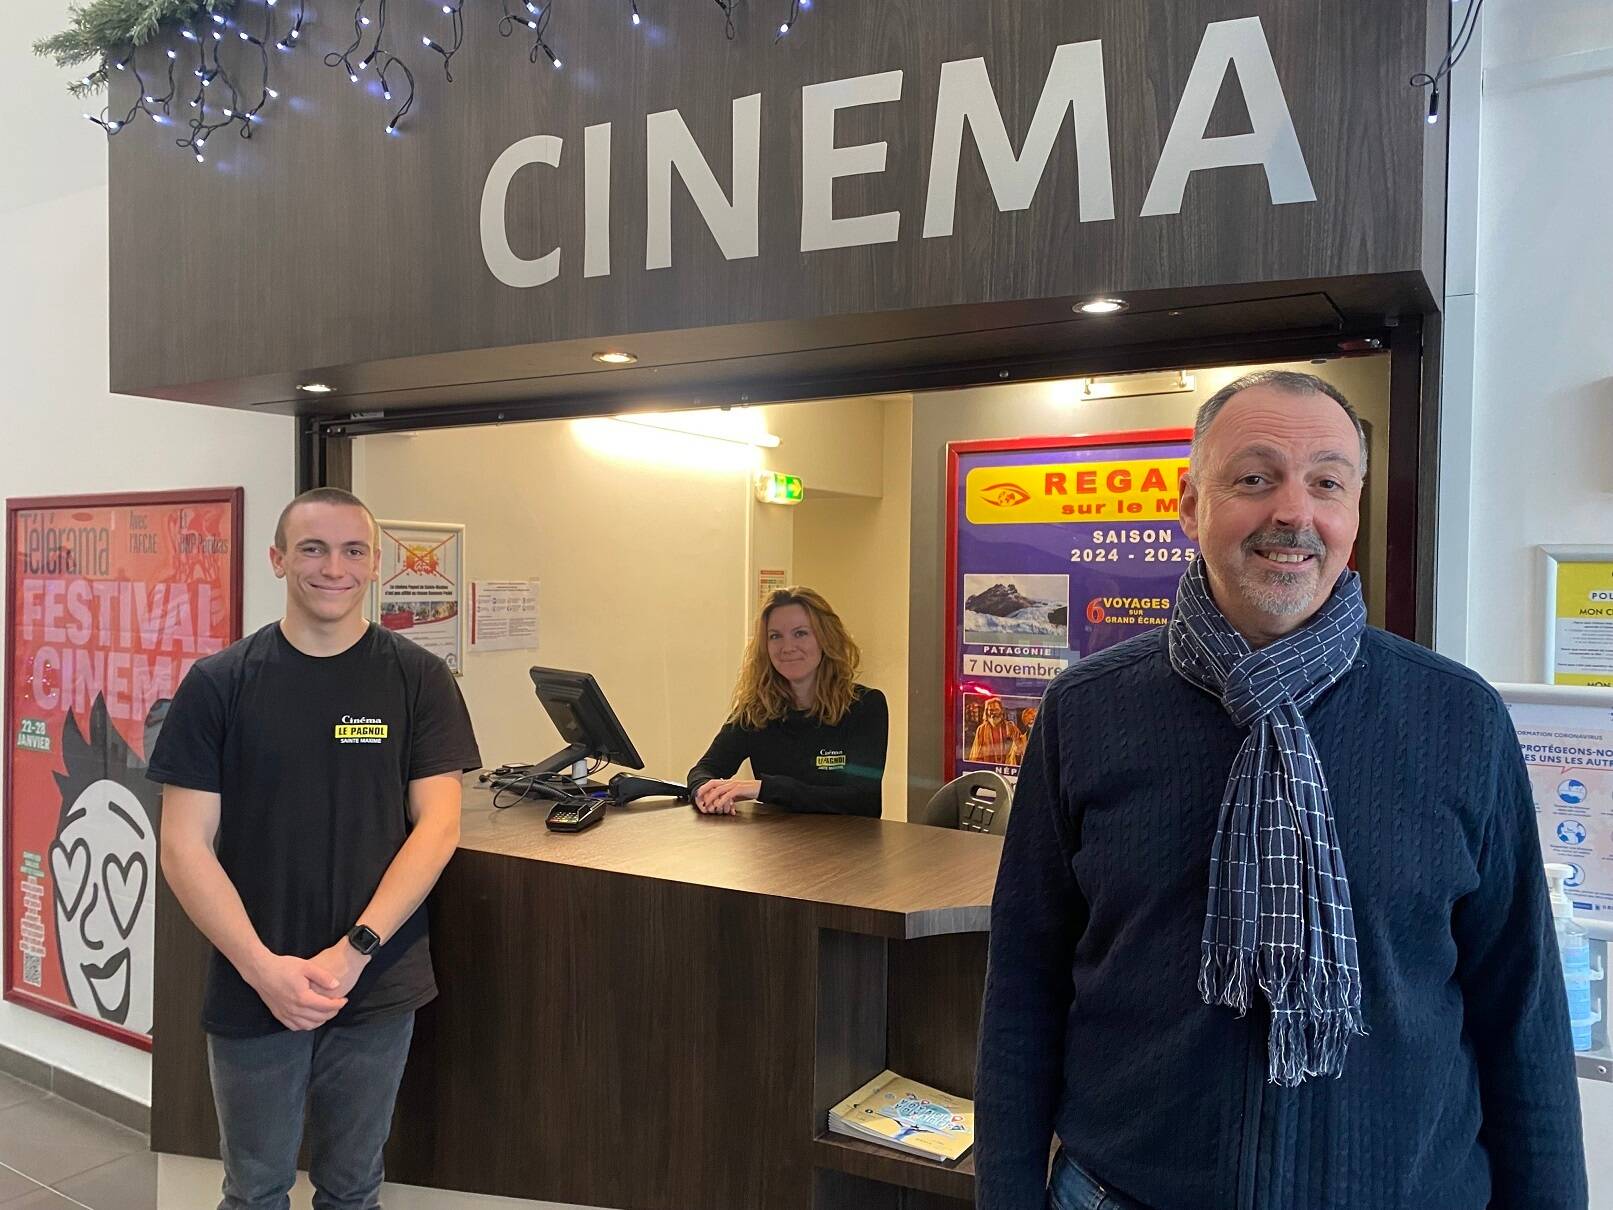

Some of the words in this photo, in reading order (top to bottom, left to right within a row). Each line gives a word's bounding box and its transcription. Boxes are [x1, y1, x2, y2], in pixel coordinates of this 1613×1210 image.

[480, 16, 1317, 288] CINEMA
[1061, 502, 1106, 515] sur
[1118, 499, 1143, 514] le
[1156, 498, 1178, 513] M
[1093, 529, 1172, 544] SAISON
[20, 511, 110, 576] Télérama
[1071, 548, 1119, 562] 2024
[1144, 548, 1195, 562] 2025
[1592, 592, 1613, 600] POL
[23, 578, 224, 654] FESTIVAL
[1087, 598, 1105, 624] 6
[1103, 597, 1170, 609] VOYAGES
[1579, 608, 1603, 616] MON
[1105, 616, 1135, 624] GRAND
[1138, 615, 1168, 625] ÉCRAN
[983, 645, 1051, 656] PATAGONIE
[969, 659, 977, 673] 7
[983, 660, 1062, 678] Novembre
[341, 714, 382, 724] Cinéma
[22, 719, 46, 735] 22-28
[338, 727, 347, 736] LE
[350, 727, 385, 736] PAGNOL
[17, 732, 50, 750] JANVIER
[1554, 732, 1603, 740] CORONAVIRUS
[1520, 744, 1613, 757] PROTÉGEONS-NO
[1522, 754, 1537, 762] ES
[1540, 754, 1562, 764] UNS
[1565, 756, 1583, 765] LES
[995, 766, 1017, 776] NÉP
